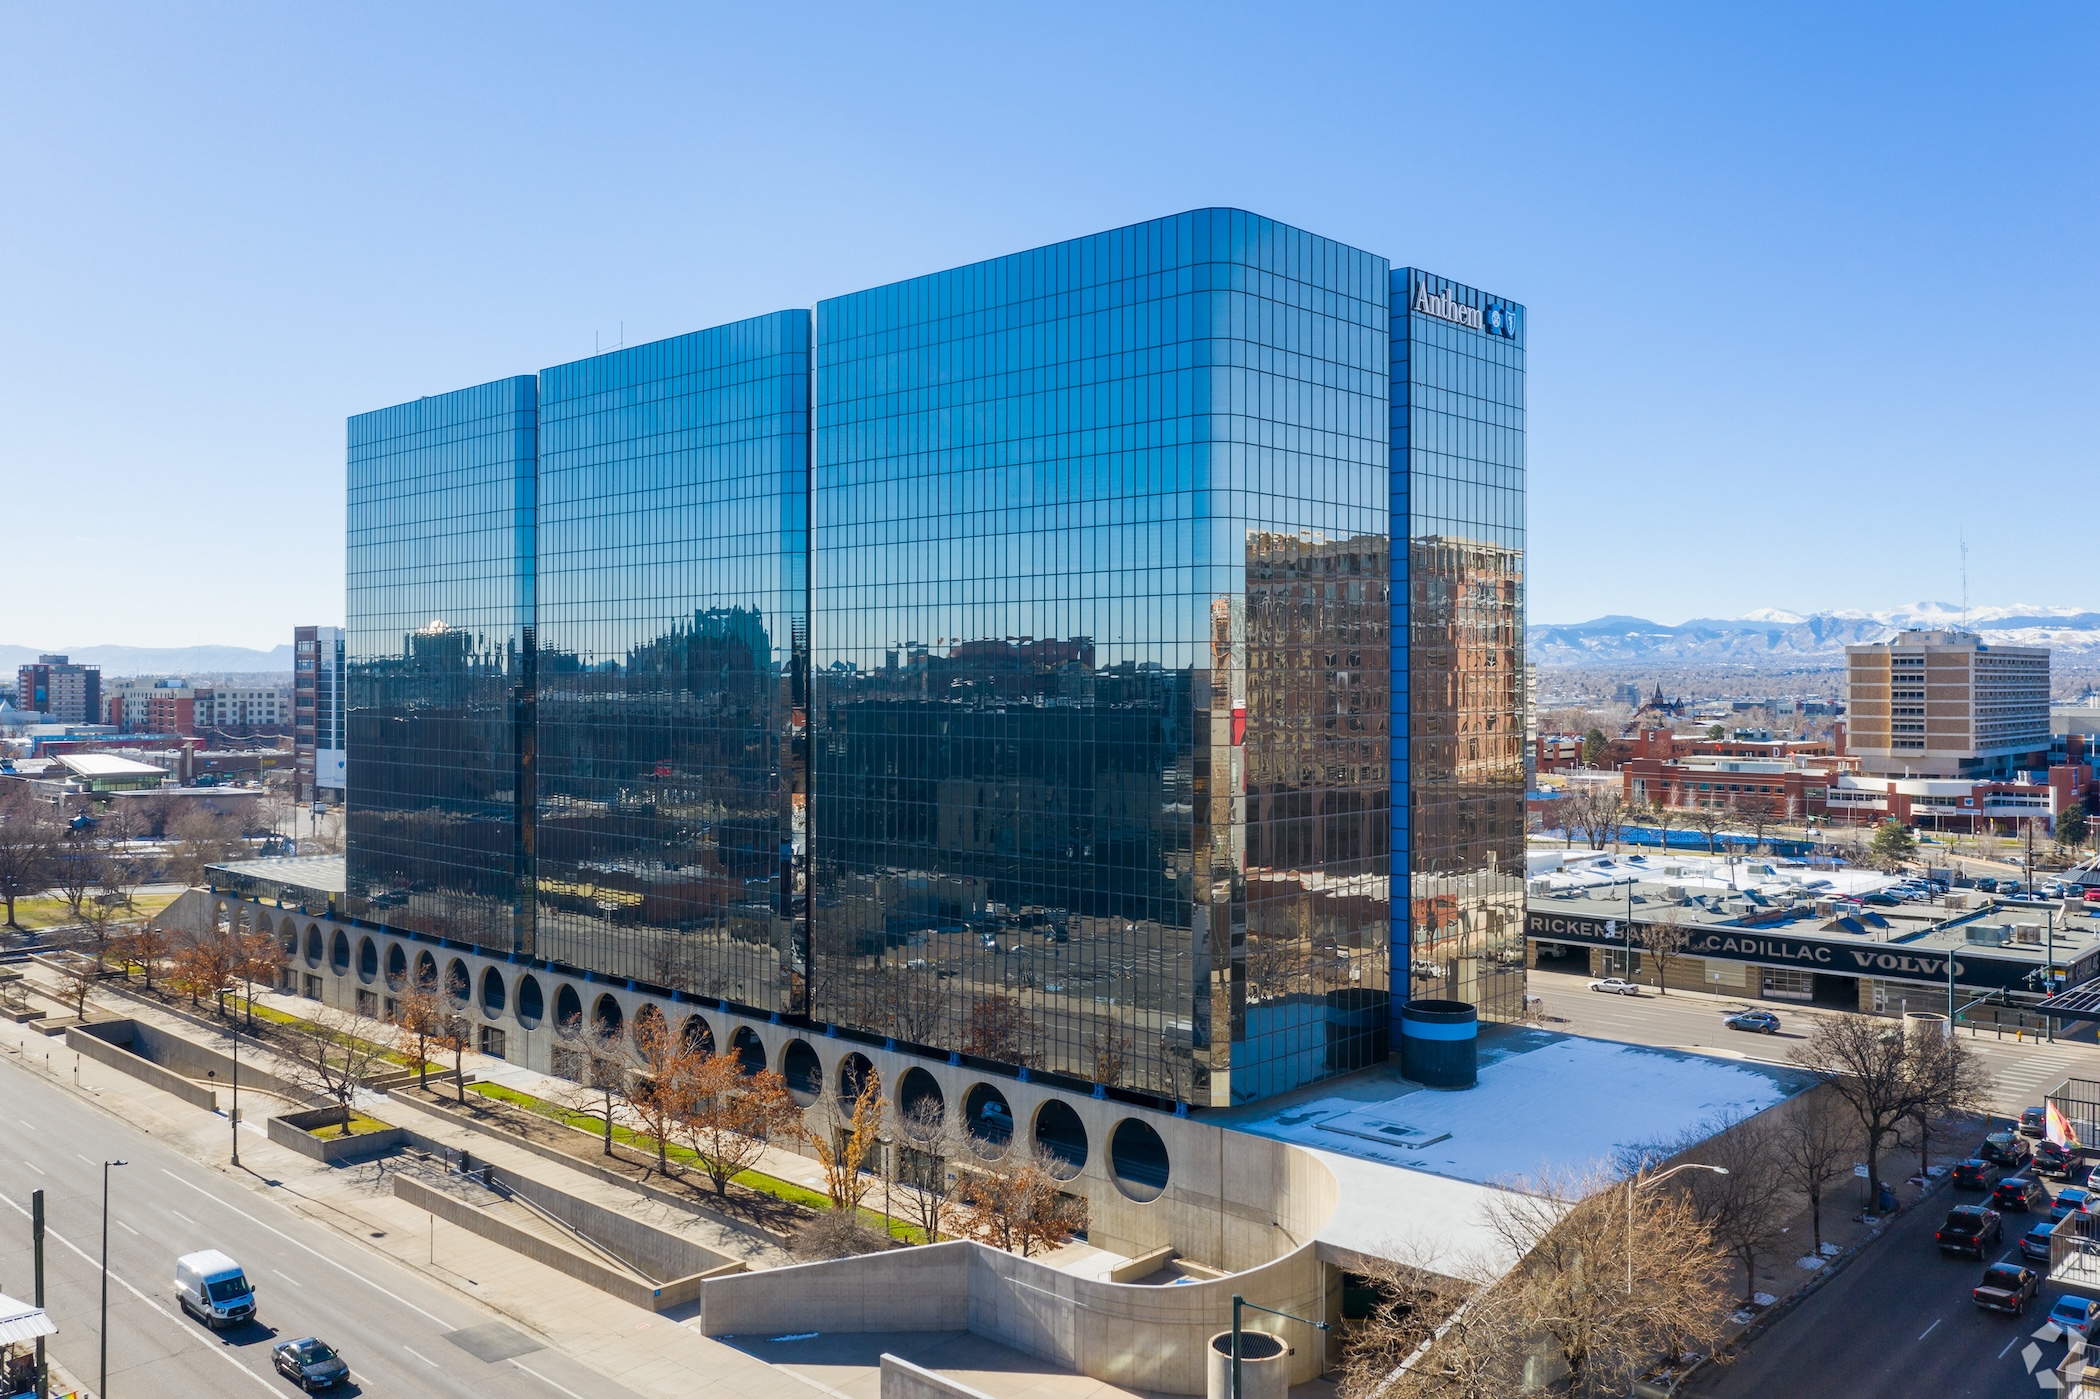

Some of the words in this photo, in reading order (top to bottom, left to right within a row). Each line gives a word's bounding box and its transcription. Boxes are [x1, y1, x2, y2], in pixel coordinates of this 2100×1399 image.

[1413, 280, 1483, 329] Anthem
[1648, 731, 1655, 742] E
[1772, 746, 1780, 758] D
[1706, 935, 1832, 963] CADILLAC
[1851, 951, 1965, 977] VOLVO
